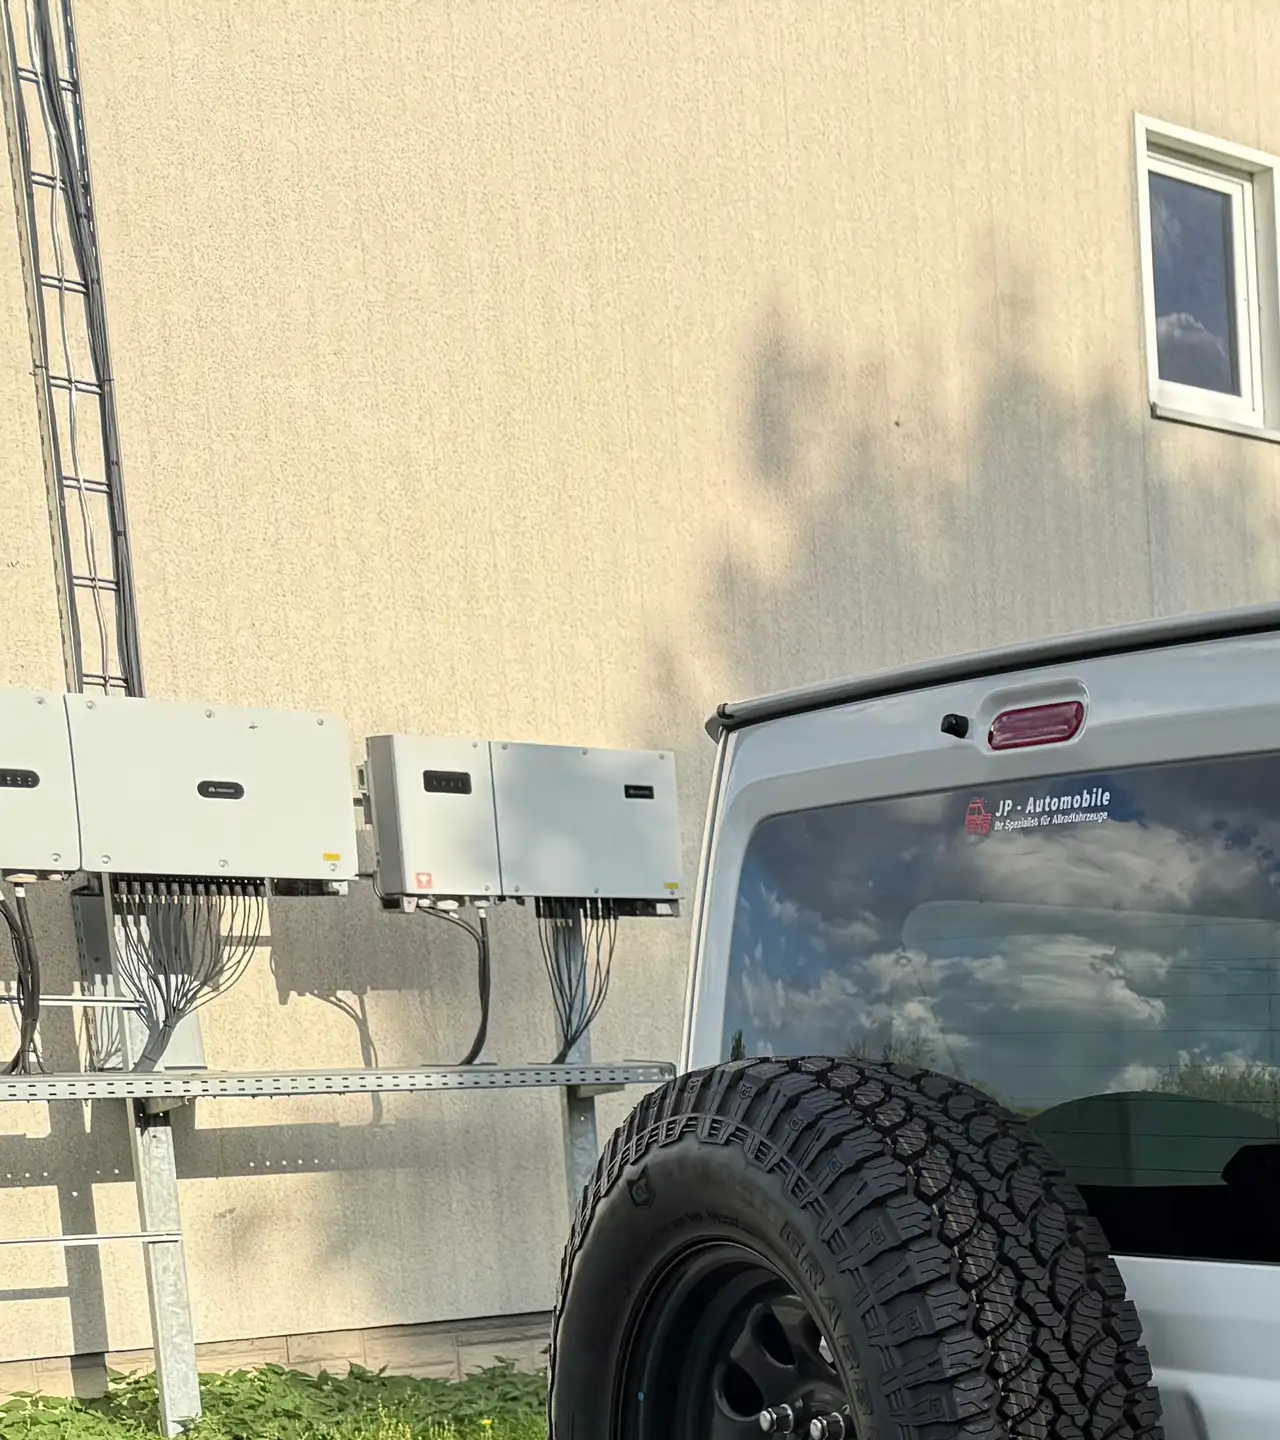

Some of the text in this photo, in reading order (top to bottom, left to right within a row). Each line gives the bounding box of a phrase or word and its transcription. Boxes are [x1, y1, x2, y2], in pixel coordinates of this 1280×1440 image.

[995, 799, 1013, 817] JP
[1025, 787, 1111, 814] Automobile
[1005, 817, 1039, 832] Spezialist
[1040, 814, 1051, 826] für
[1052, 811, 1108, 825] Allradfahrzeuge
